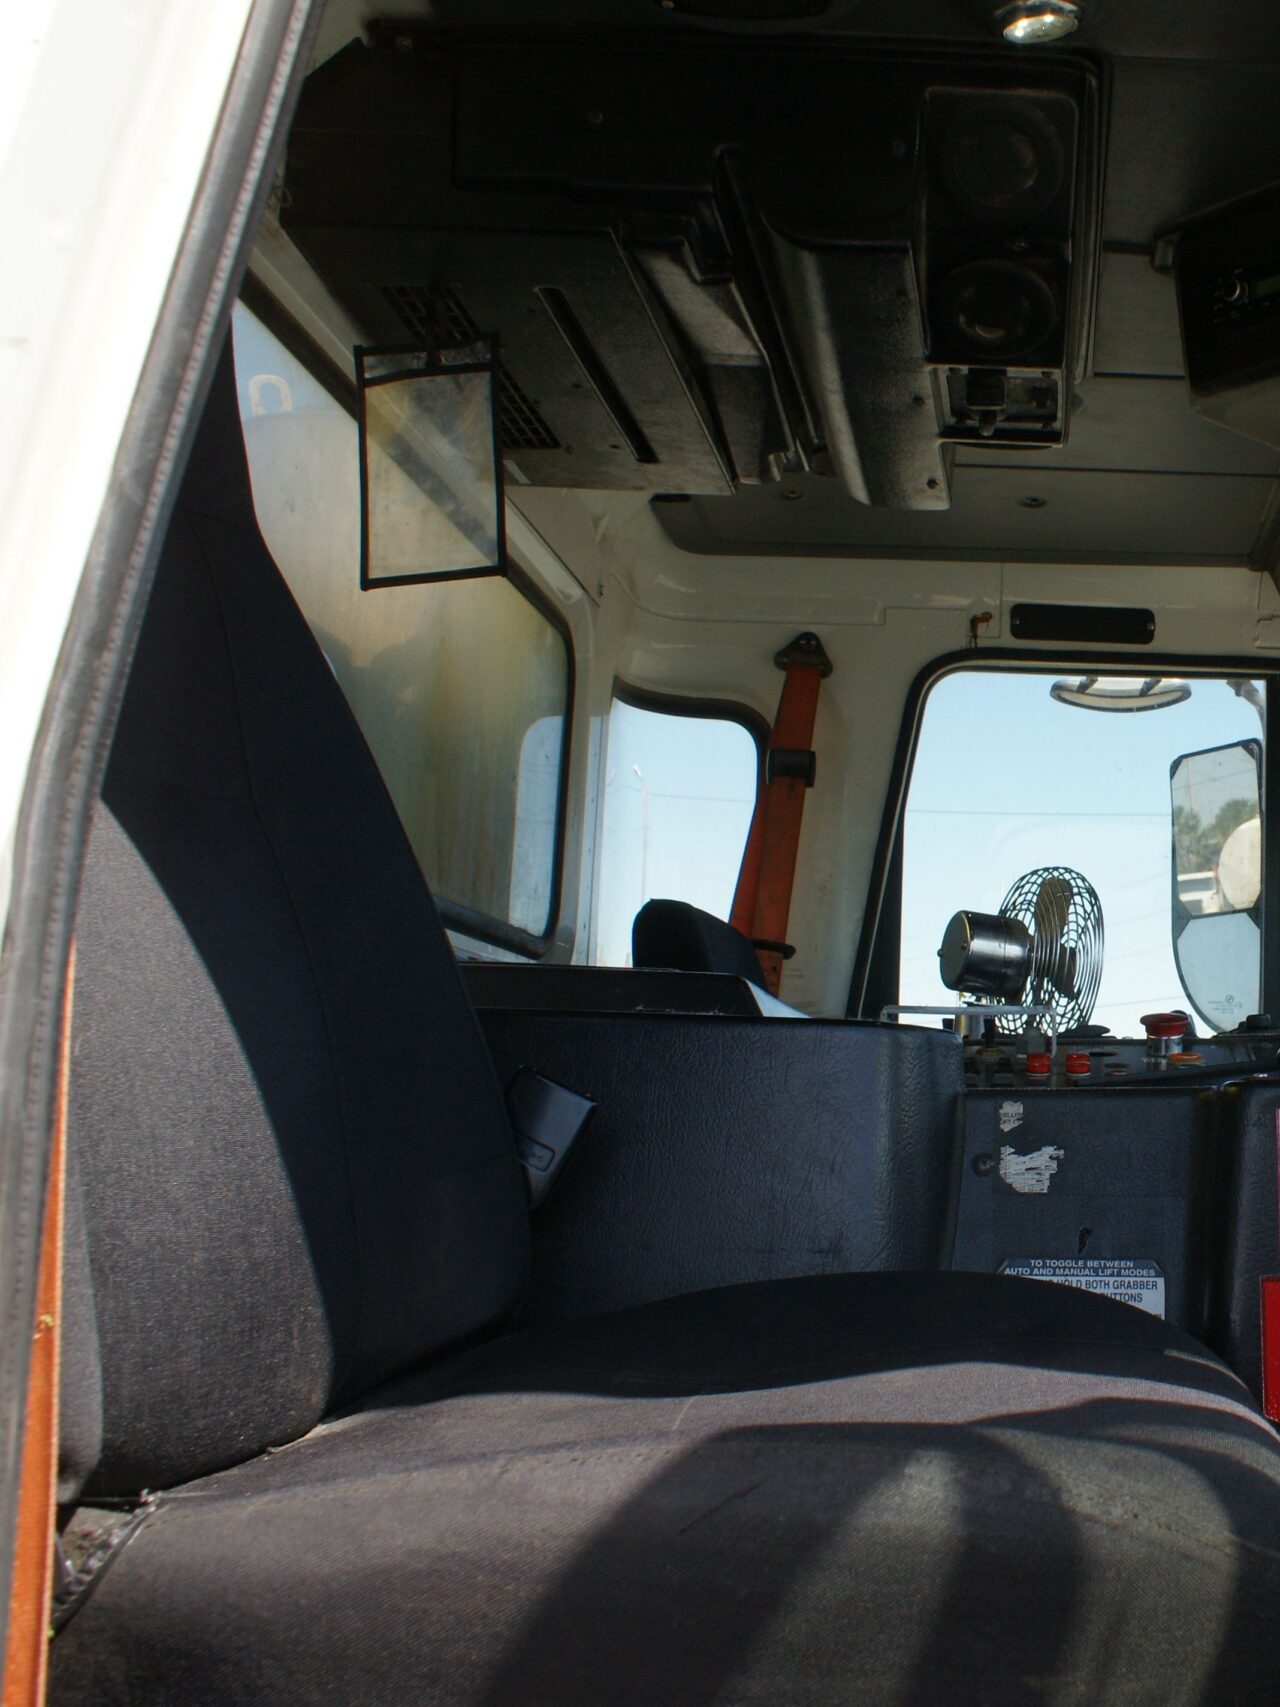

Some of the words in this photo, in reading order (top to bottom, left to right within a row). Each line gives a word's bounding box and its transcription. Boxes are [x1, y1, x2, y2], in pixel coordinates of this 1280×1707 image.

[1030, 1259, 1043, 1267] TO
[1045, 1259, 1084, 1268] TOGGLE
[1087, 1260, 1134, 1268] BETWEEN
[1004, 1267, 1030, 1275] AUTO
[1032, 1267, 1054, 1275] AND
[1055, 1268, 1096, 1276] MANUAL
[1098, 1268, 1119, 1276] LIFT
[1121, 1268, 1156, 1276] MODES
[1085, 1280, 1110, 1290] BOTH
[1112, 1280, 1158, 1290] GRABBER
